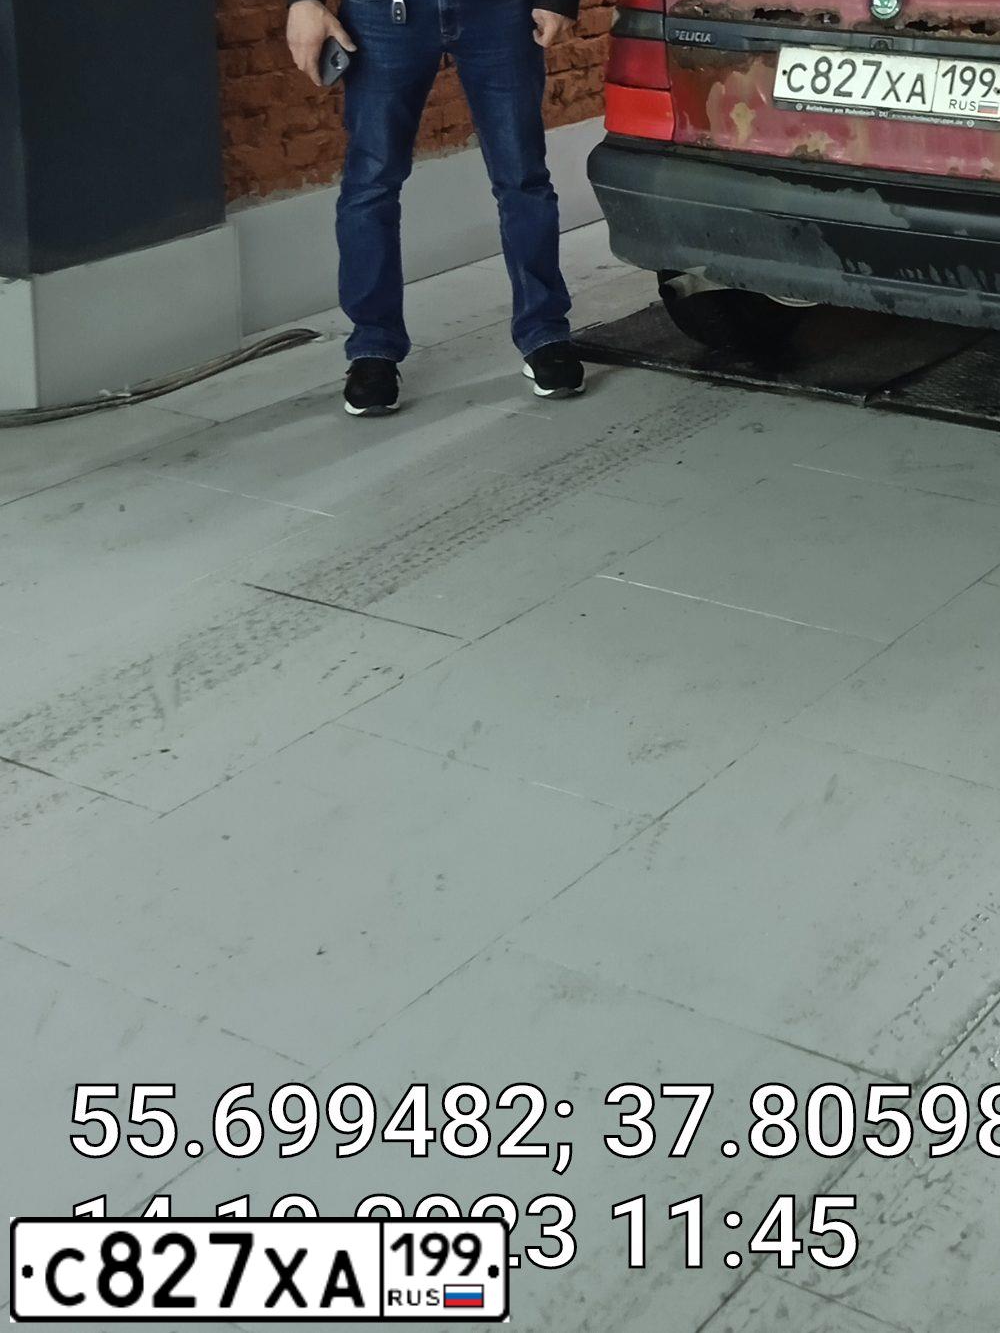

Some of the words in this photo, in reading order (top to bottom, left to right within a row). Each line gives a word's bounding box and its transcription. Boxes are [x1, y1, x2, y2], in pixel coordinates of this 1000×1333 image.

[786, 56, 927, 105] С827ХА
[942, 64, 996, 98] 199
[949, 99, 977, 112] RUS
